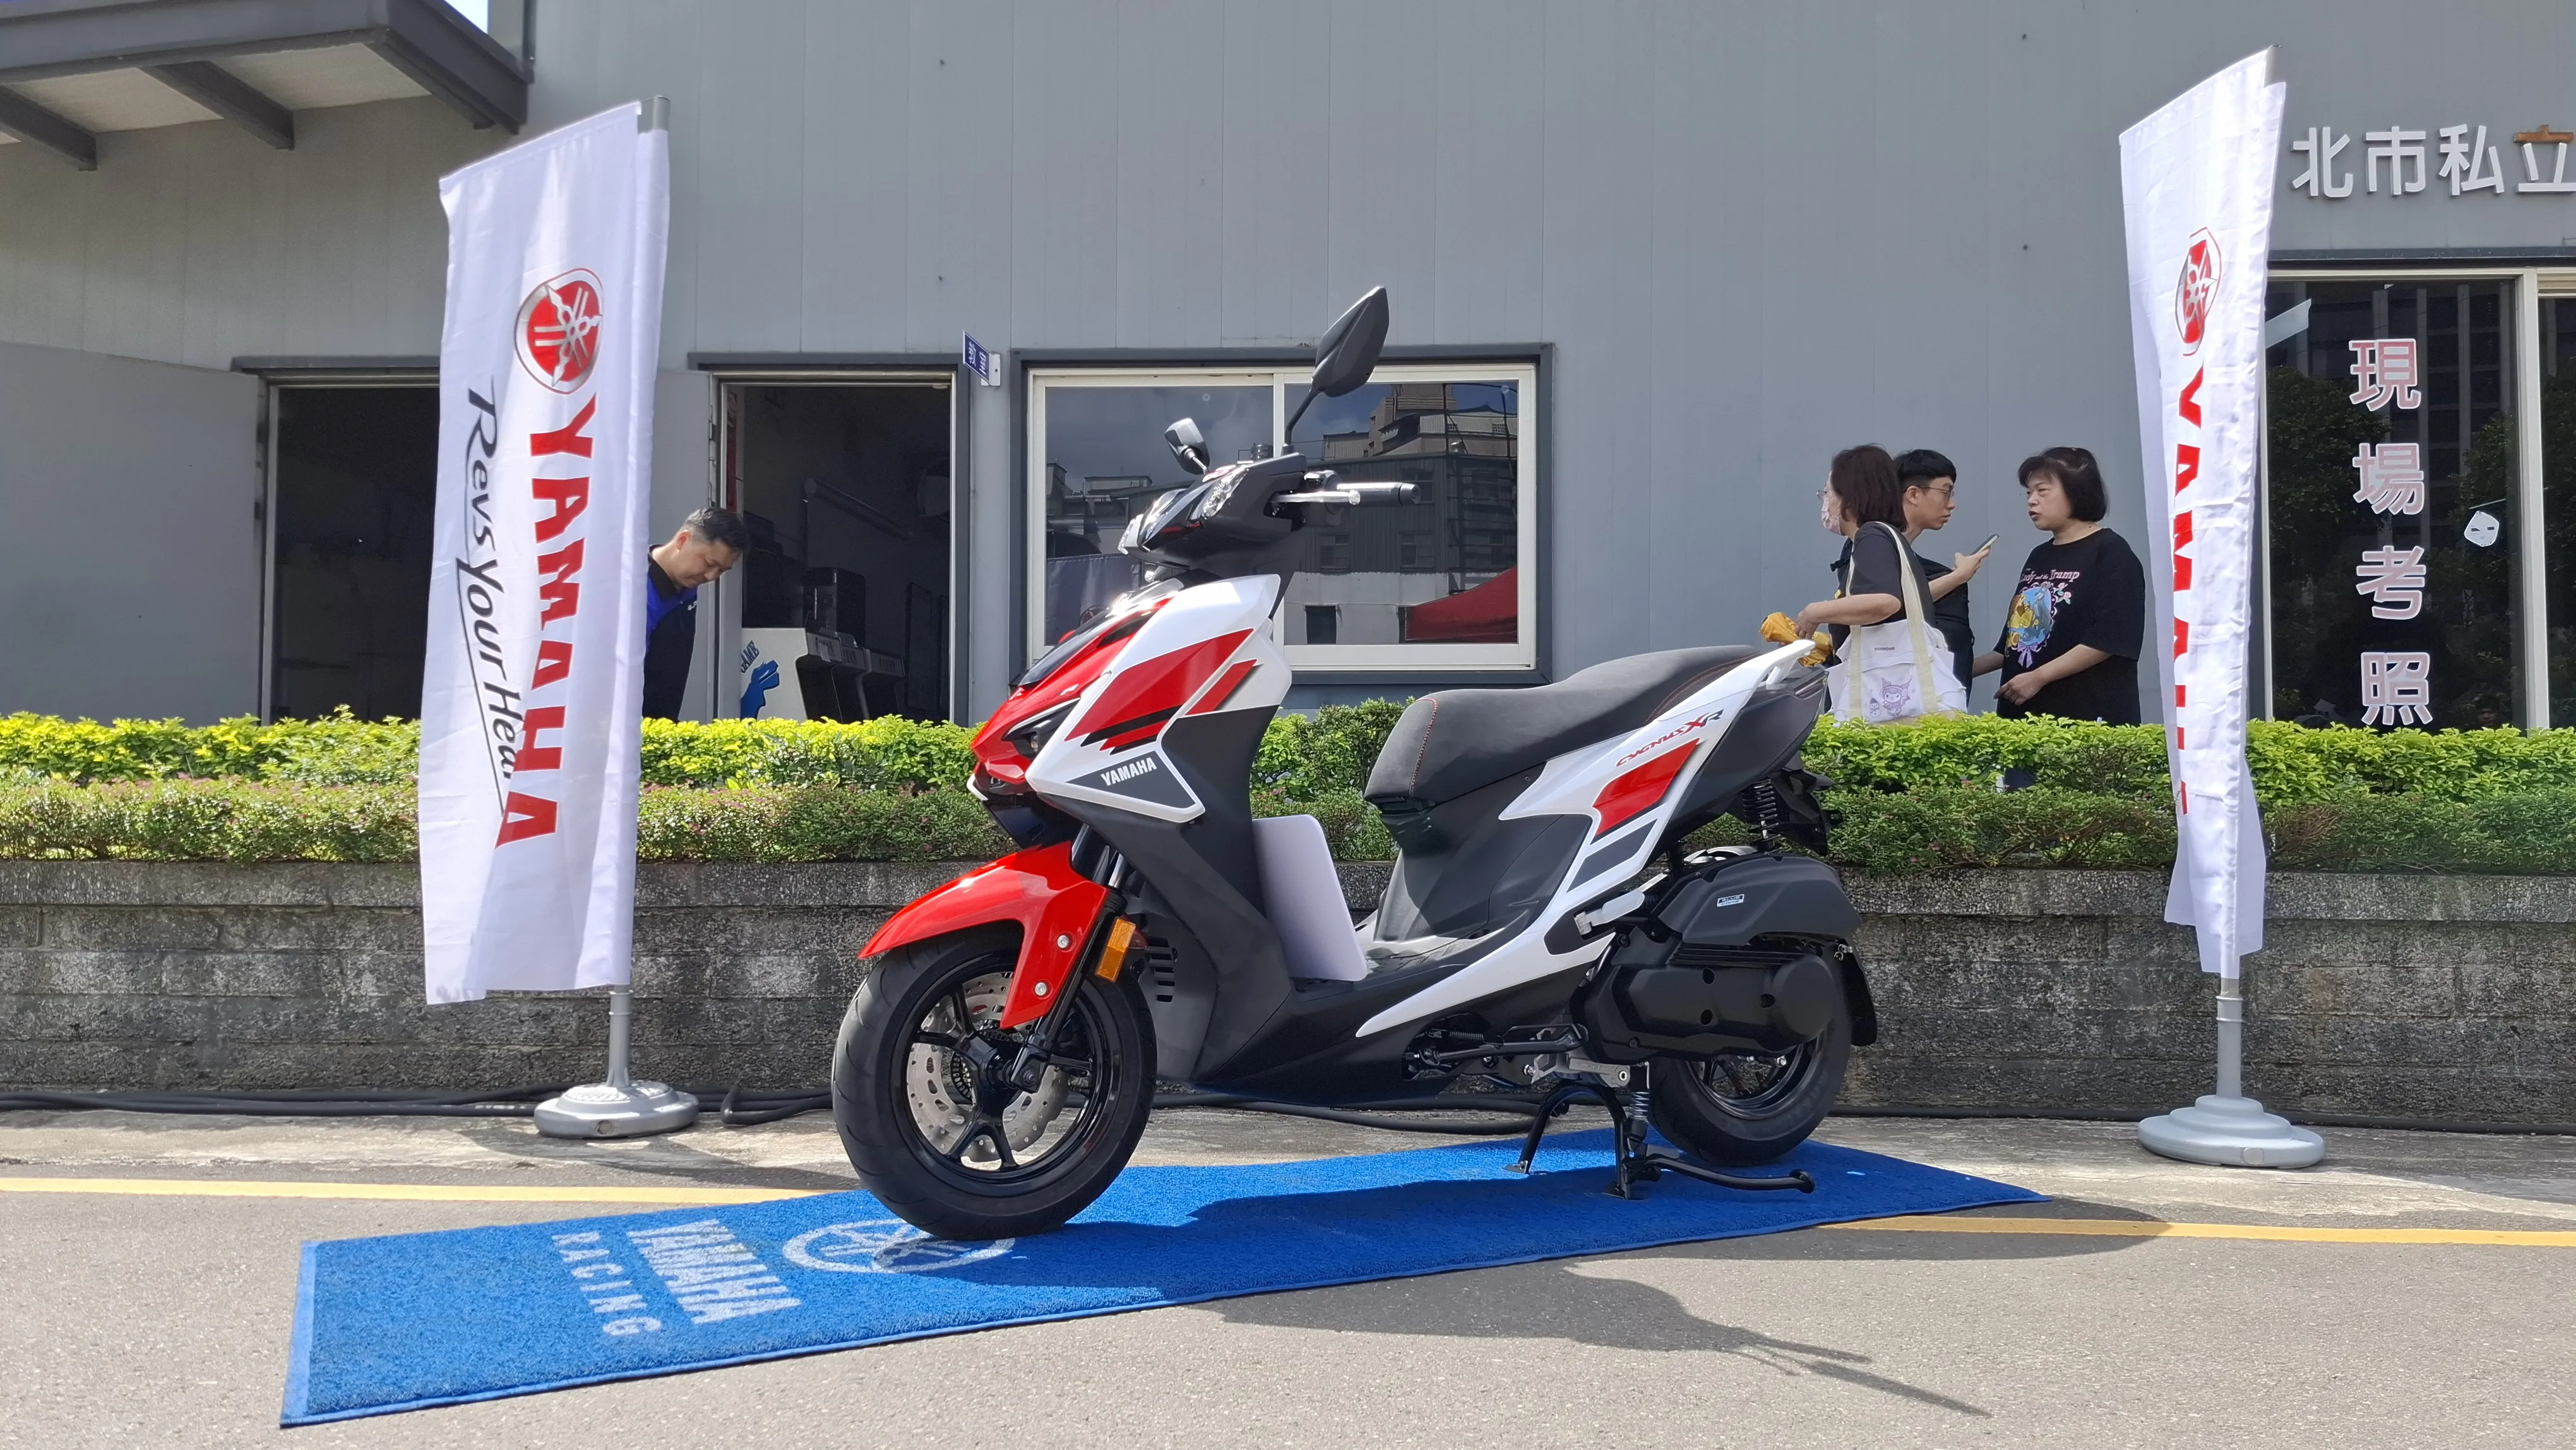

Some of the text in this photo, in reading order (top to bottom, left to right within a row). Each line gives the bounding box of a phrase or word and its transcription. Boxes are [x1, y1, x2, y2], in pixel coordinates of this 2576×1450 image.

[2291, 124, 2576, 197] 北市私立
[968, 341, 987, 375] 教室
[457, 376, 524, 779] Revs Your Hea
[2349, 338, 2433, 726] 現場考照
[495, 392, 597, 849] YAMAHA
[2173, 364, 2205, 815] YAMA
[1100, 757, 1157, 786] YAMAHA
[551, 1230, 662, 1336] RACING
[626, 1218, 802, 1325] YAMAHA
